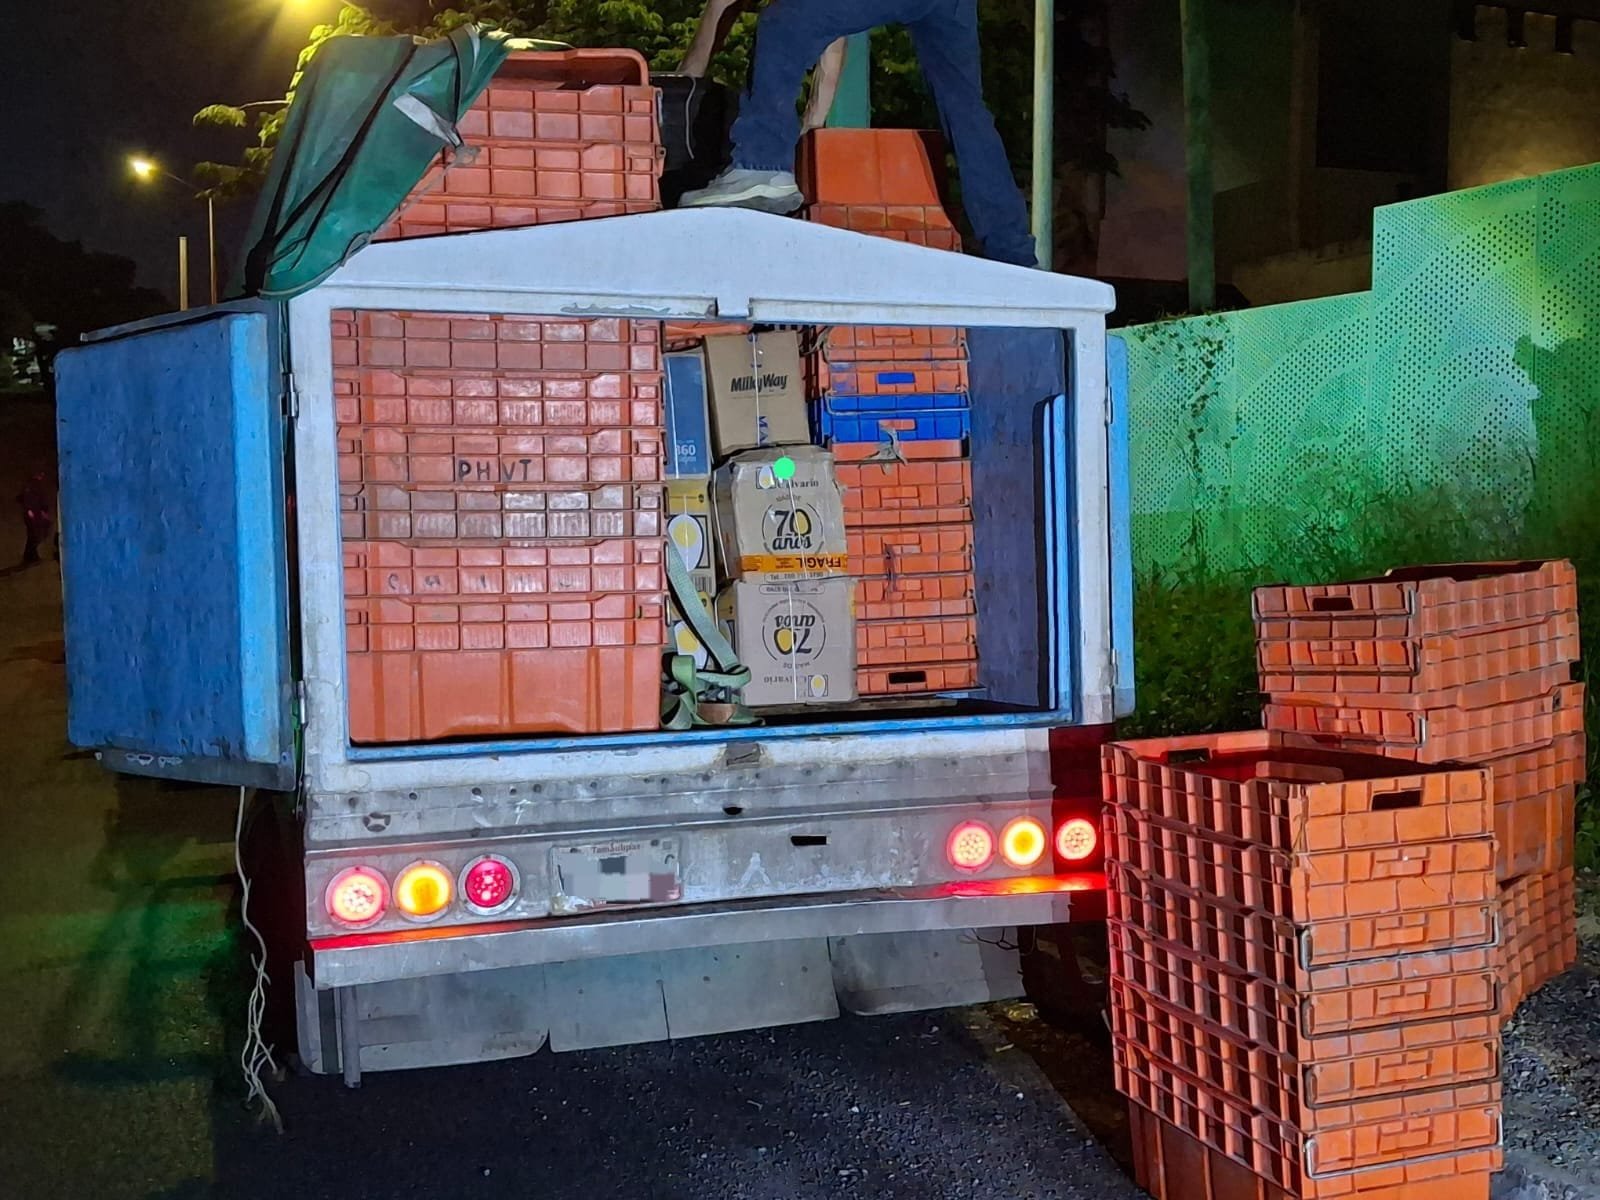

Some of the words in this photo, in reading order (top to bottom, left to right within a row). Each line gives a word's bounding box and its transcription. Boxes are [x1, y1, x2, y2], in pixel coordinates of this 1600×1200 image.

[774, 508, 812, 537] 70
[772, 533, 812, 551] años
[774, 615, 815, 632] años
[773, 628, 812, 656] 70
